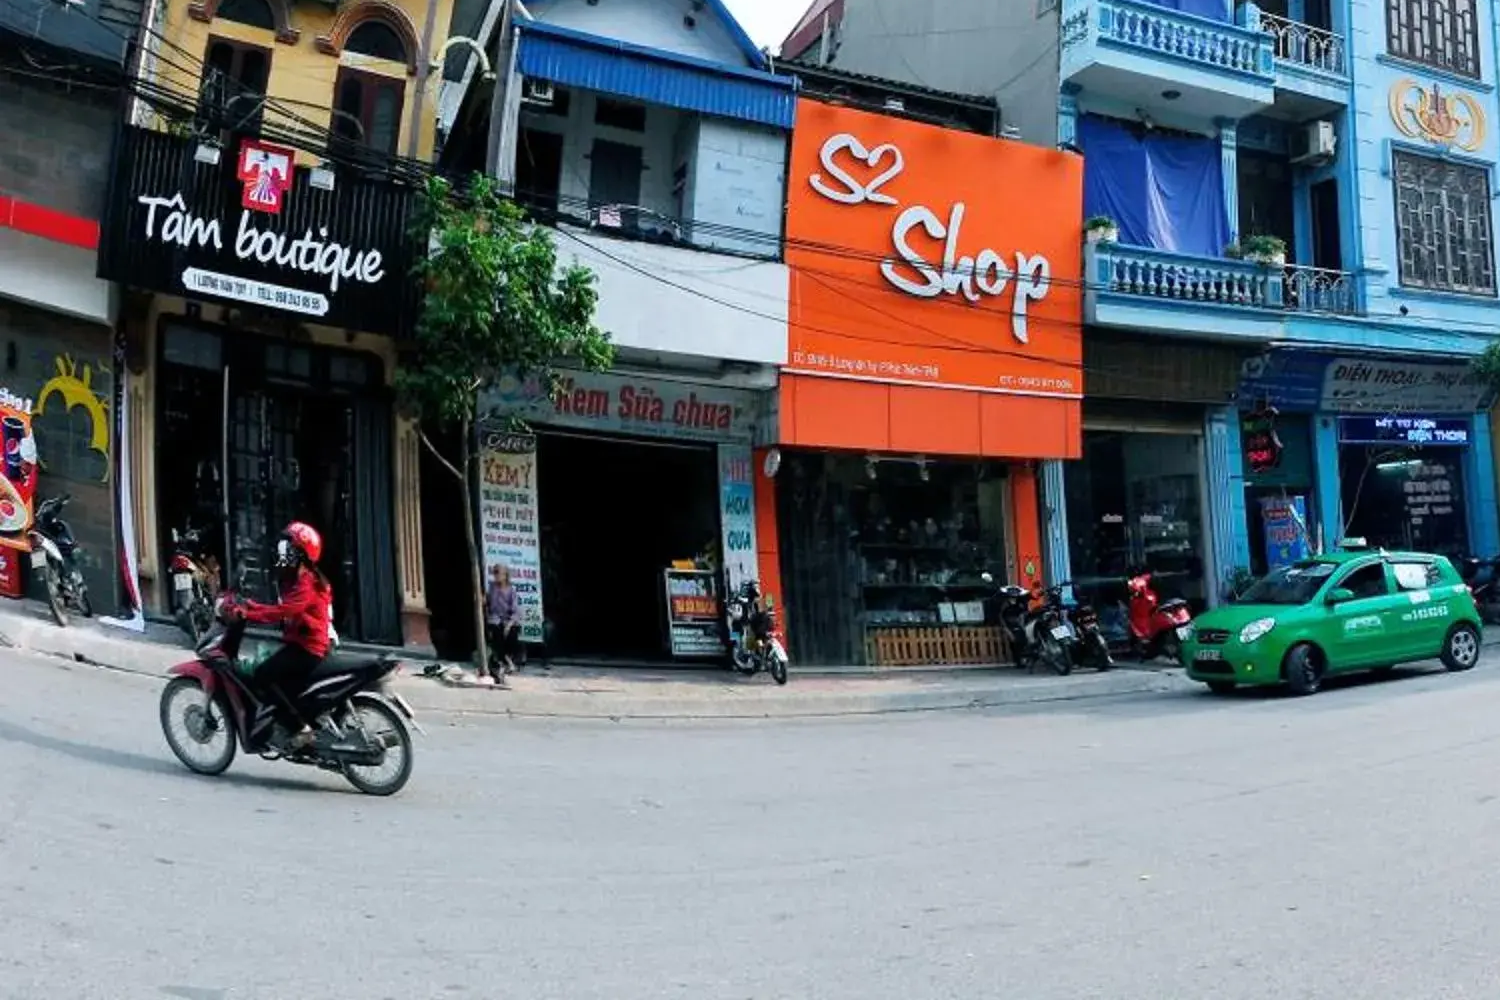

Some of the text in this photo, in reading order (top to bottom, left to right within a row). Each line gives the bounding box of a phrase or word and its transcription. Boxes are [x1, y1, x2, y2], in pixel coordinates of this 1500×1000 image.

[138, 191, 386, 293] Tâm boutique
[880, 201, 1050, 345] Shop
[617, 384, 664, 422] Sữa
[725, 496, 750, 515] HOA
